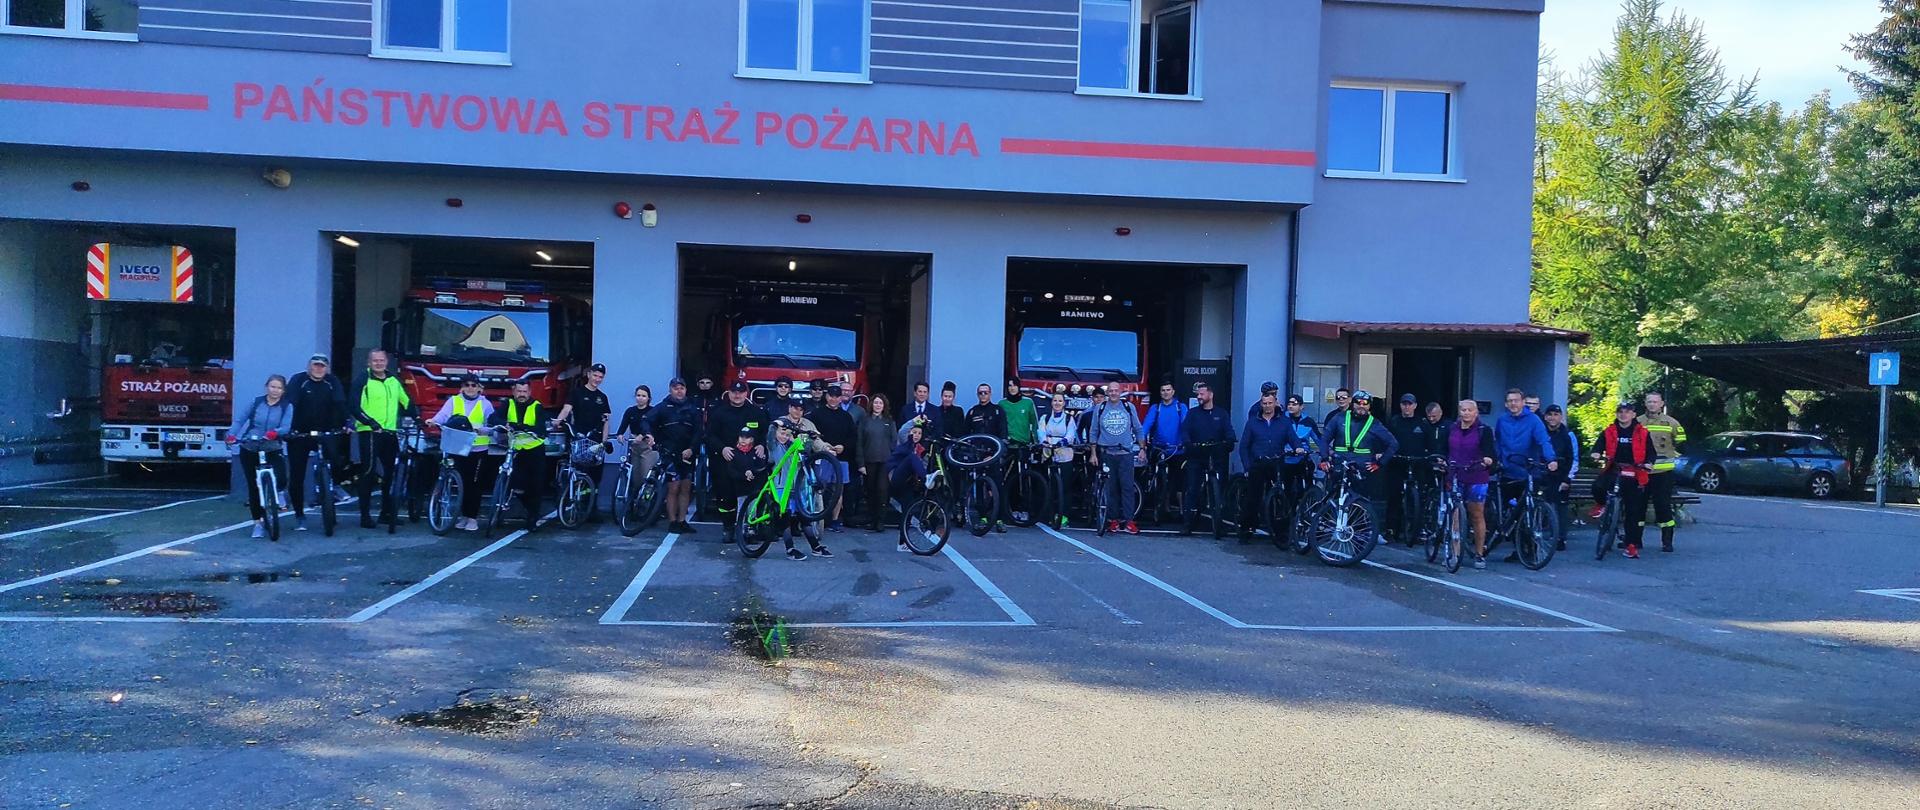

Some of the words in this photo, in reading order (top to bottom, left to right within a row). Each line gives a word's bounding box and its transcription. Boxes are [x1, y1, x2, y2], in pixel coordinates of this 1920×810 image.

[232, 79, 568, 136] PAŃSTWOWA
[582, 101, 741, 146] STRAŻ
[754, 109, 980, 157] POŻARNA
[119, 264, 160, 274] IVECO
[780, 295, 818, 305] BRANIEWO
[1877, 358, 1892, 379] P
[121, 381, 161, 391] STRAŻ
[164, 381, 227, 393] POŻARNA
[158, 404, 189, 413] IVECO
